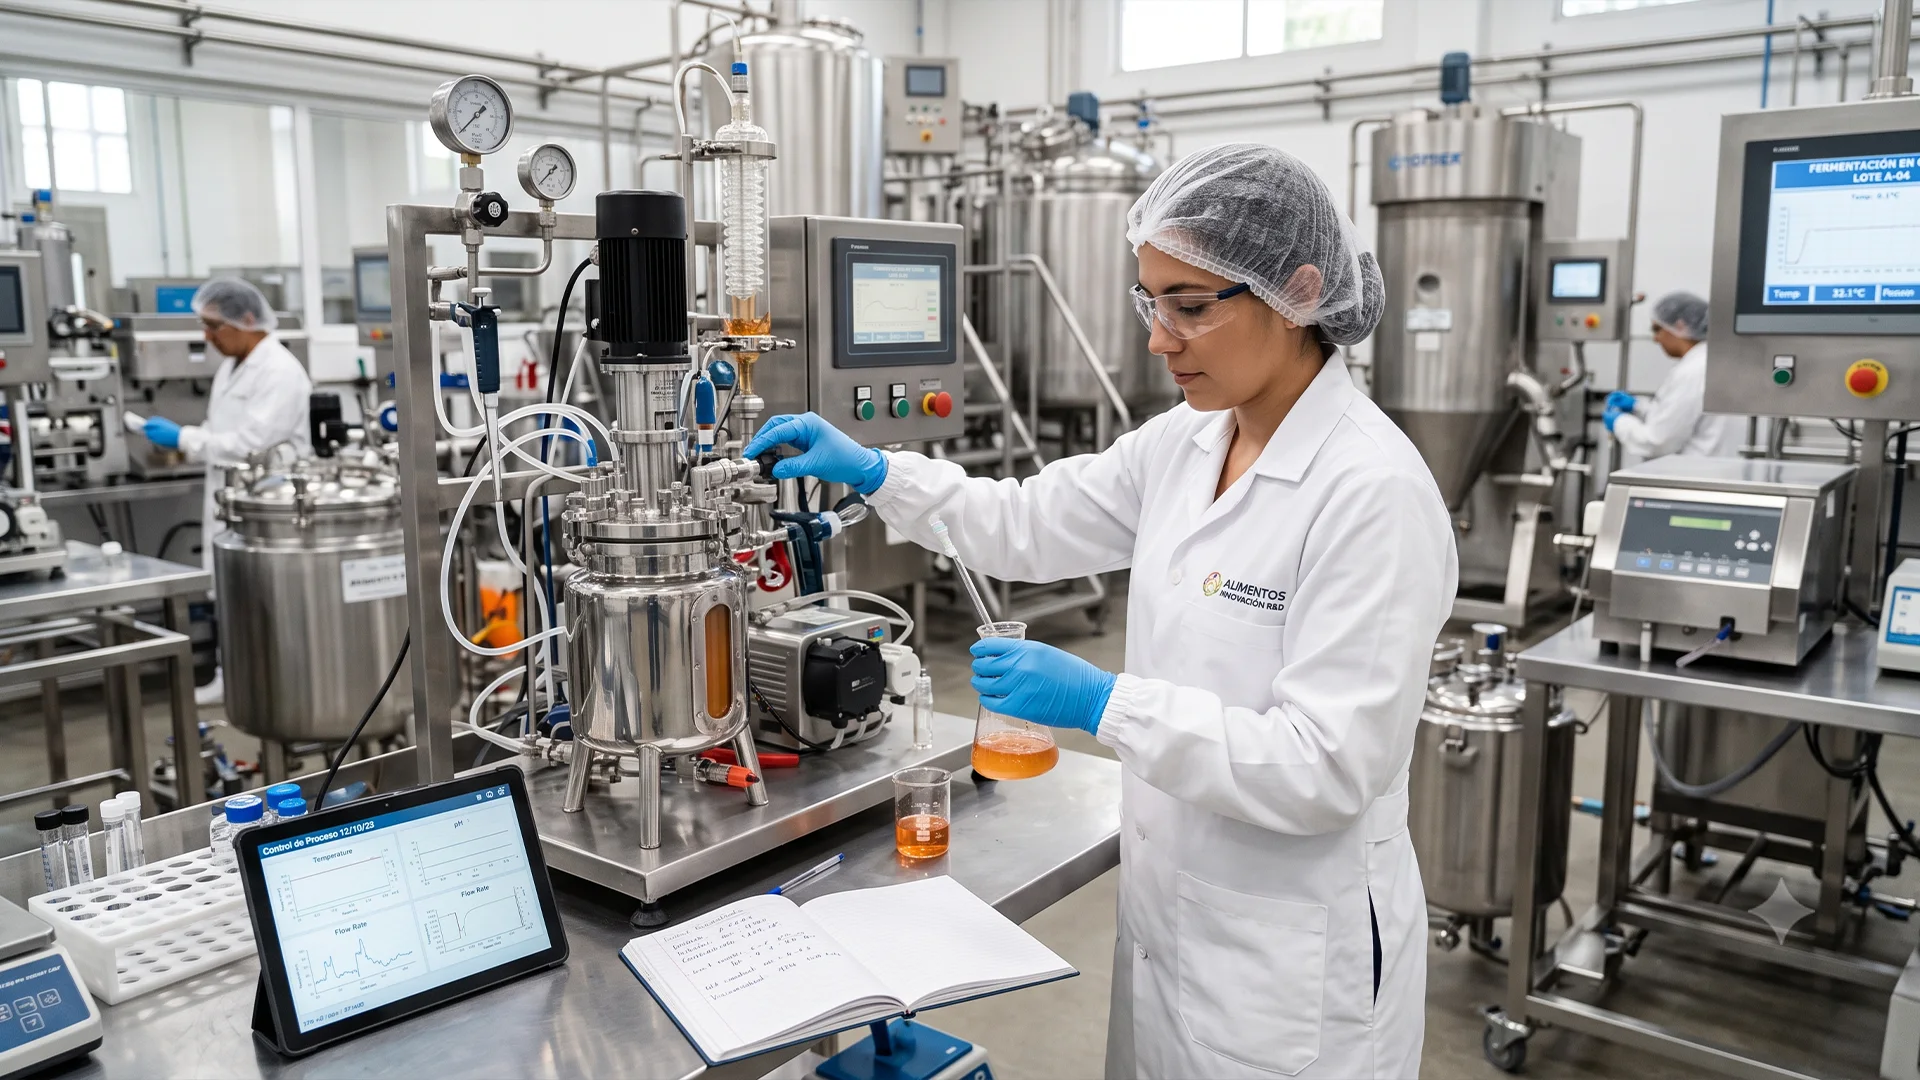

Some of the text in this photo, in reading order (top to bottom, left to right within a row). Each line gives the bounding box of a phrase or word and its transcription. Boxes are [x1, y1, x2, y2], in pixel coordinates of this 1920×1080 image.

[1808, 158, 1897, 173] FERMENTACIÓN
[1899, 158, 1915, 168] EN
[1853, 170, 1911, 183] LOTE A-04
[1773, 289, 1801, 299] Temp
[1223, 579, 1286, 601] ALIMENTOS
[1219, 590, 1285, 611] INNOVACIÓN R&D
[453, 820, 464, 829] pH
[262, 820, 375, 856] Control de Proceso 12/10/23
[312, 849, 353, 863] Temperature
[461, 884, 490, 898] Flow Rate
[334, 921, 367, 936] Flow Rate
